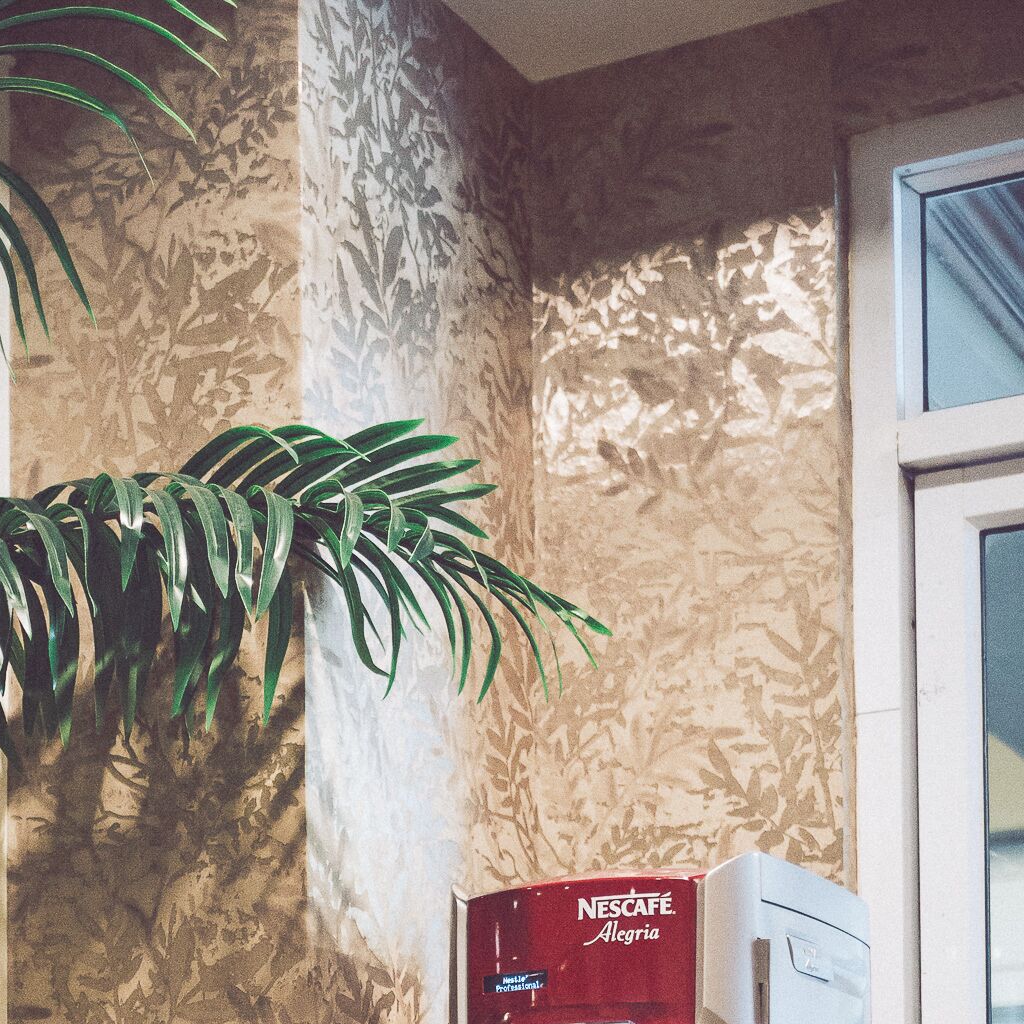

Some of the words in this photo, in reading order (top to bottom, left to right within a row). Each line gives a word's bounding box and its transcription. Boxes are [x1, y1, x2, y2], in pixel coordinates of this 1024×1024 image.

[577, 889, 674, 920] NESCAFÉ
[583, 921, 660, 945] Alegria
[495, 980, 540, 993] Professional
